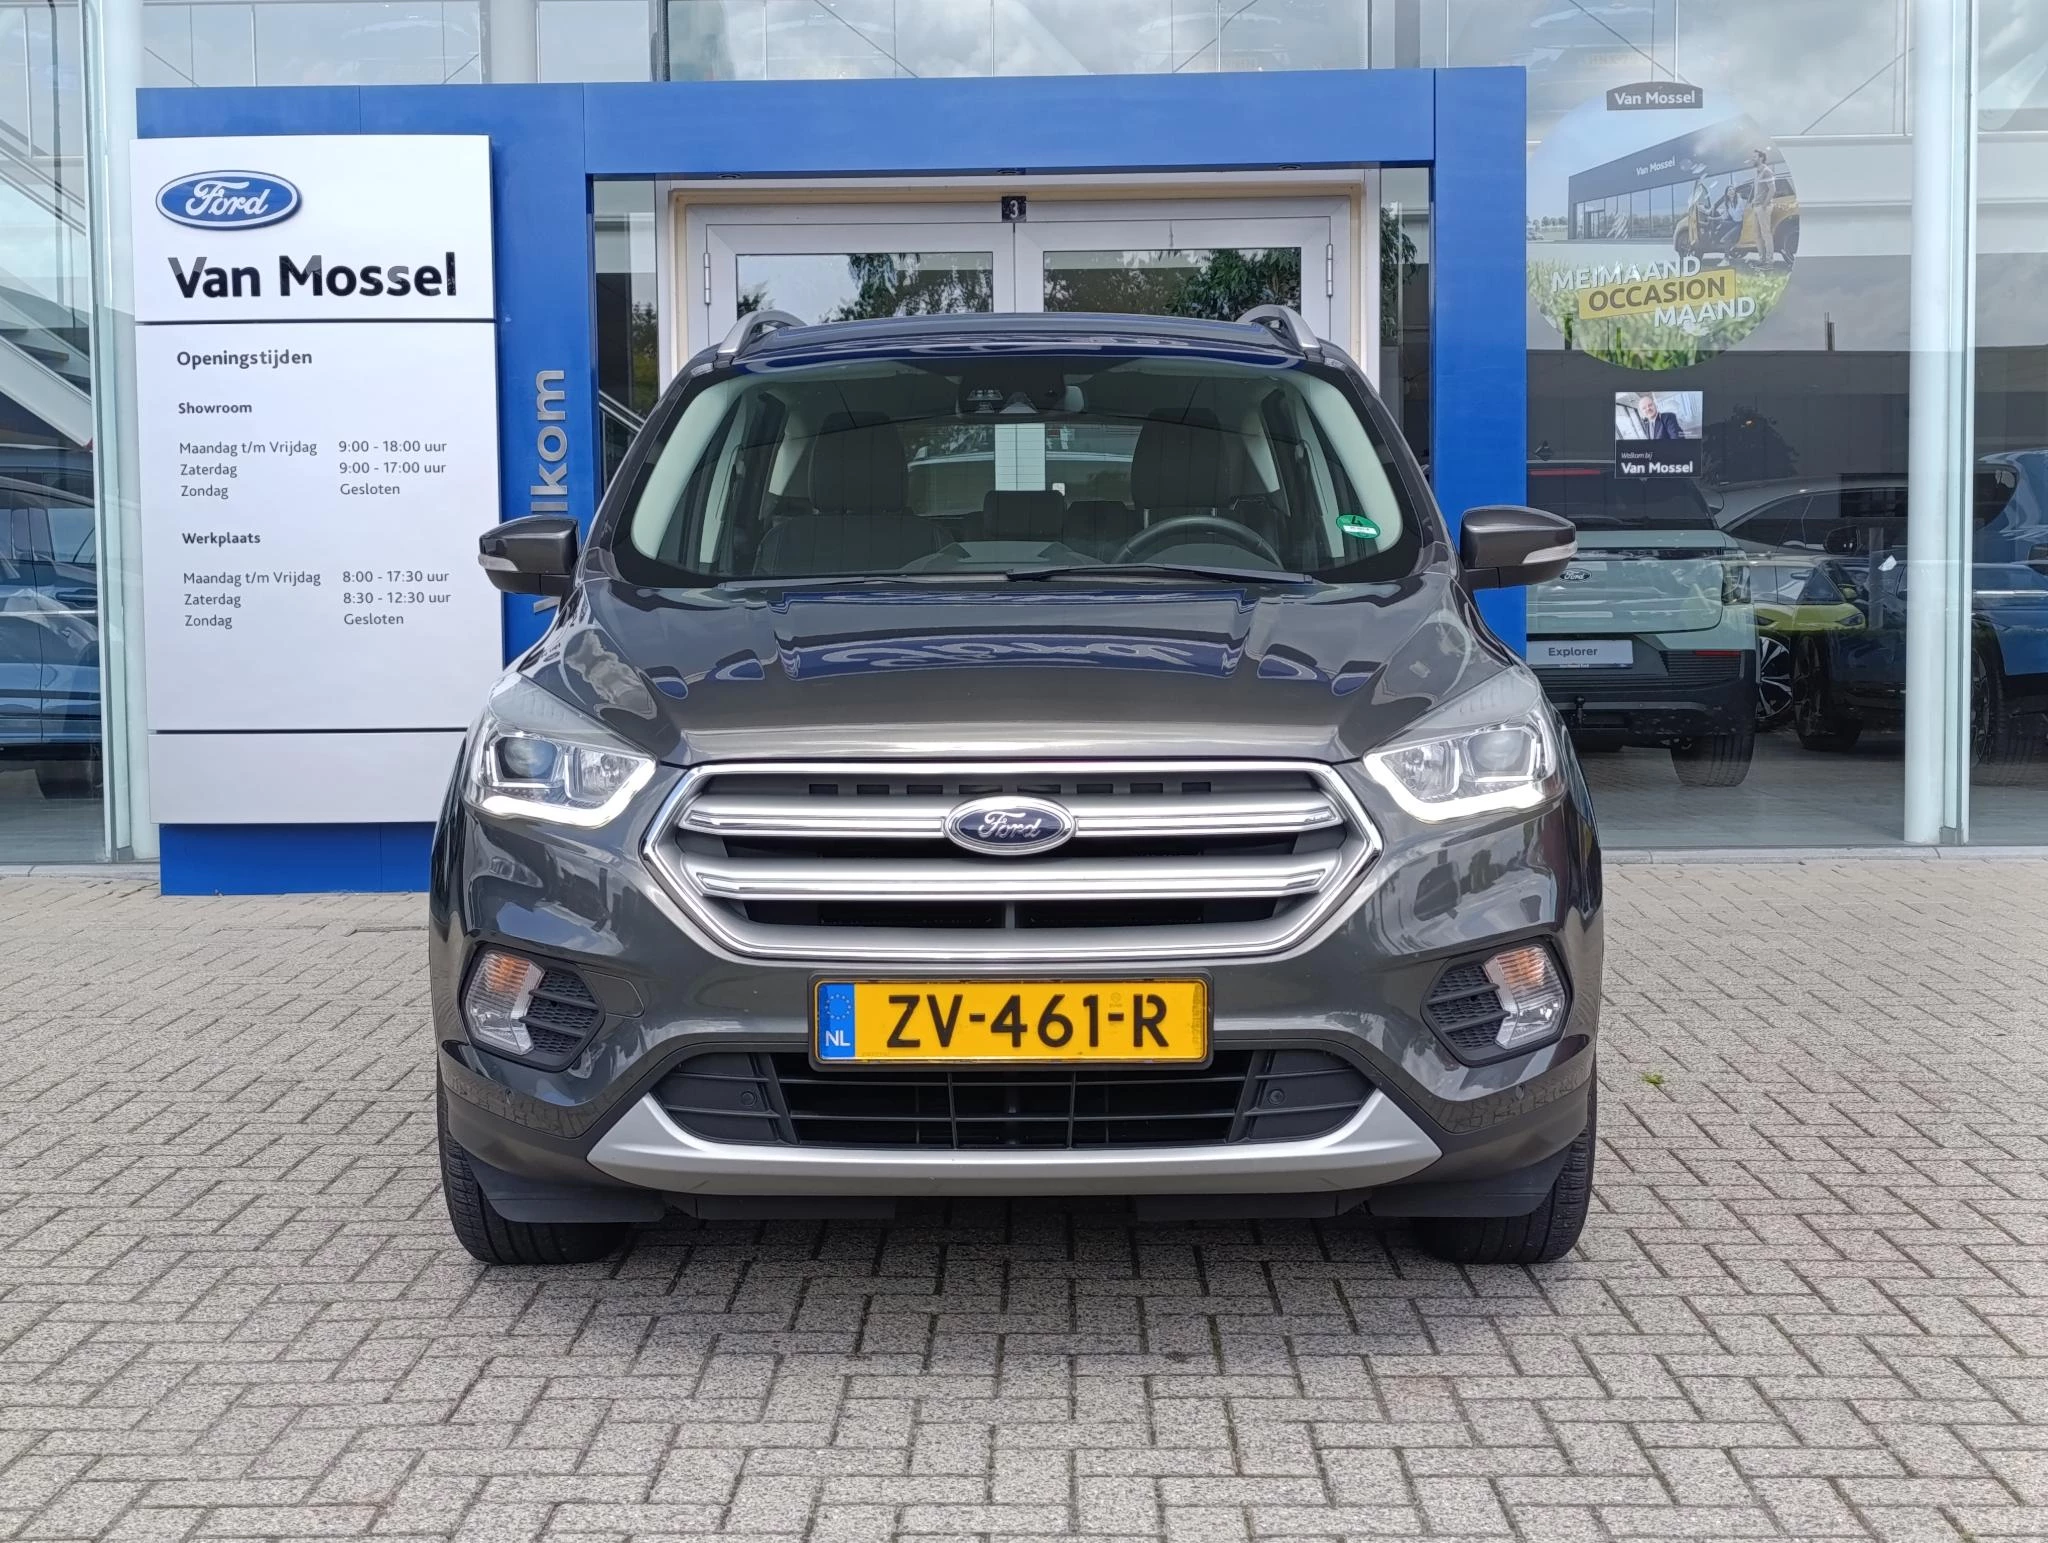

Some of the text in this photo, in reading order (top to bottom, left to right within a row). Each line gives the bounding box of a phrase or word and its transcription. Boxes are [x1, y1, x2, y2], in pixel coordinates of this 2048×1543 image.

[1614, 90, 1696, 105] Van Mossel
[185, 180, 271, 216] Ford
[1010, 199, 1019, 218] 3
[168, 252, 457, 298] Van Mossel
[1551, 254, 1702, 292] MEIMAAND
[1588, 276, 1725, 312] OCCASION
[1654, 296, 1757, 328] MAAND
[177, 349, 313, 370] Openingstijden
[178, 402, 253, 414] Showroom
[179, 441, 238, 457] Maandag
[242, 441, 266, 454] t/m
[270, 441, 318, 456] Vrijdag
[338, 440, 370, 453] 9:00
[383, 440, 421, 453] 18:00
[424, 443, 448, 453] uur
[180, 463, 238, 478] Zaterdag
[339, 461, 370, 474] 9:00
[383, 461, 420, 474] 17:00
[424, 464, 447, 474] uur
[1621, 461, 1694, 474] Van Mossel
[181, 483, 401, 499] Zondag Gesloten
[182, 532, 261, 547] Werkplaats
[183, 572, 242, 587] Maandag
[245, 571, 270, 584] t/m
[273, 571, 321, 586] Vrijdag
[342, 571, 374, 583] 8:00
[386, 570, 424, 582] 17:30
[427, 573, 450, 582] uur
[184, 593, 242, 608] Zaterdag
[343, 592, 374, 604] 8:30
[387, 591, 425, 604] 12:30
[429, 594, 452, 604] uur
[184, 613, 404, 629] Zondag Gesloten
[1548, 646, 1599, 658] Explorer
[978, 811, 1042, 838] Ford
[886, 993, 1169, 1049] ZV-461-R
[825, 1030, 851, 1047] NL
